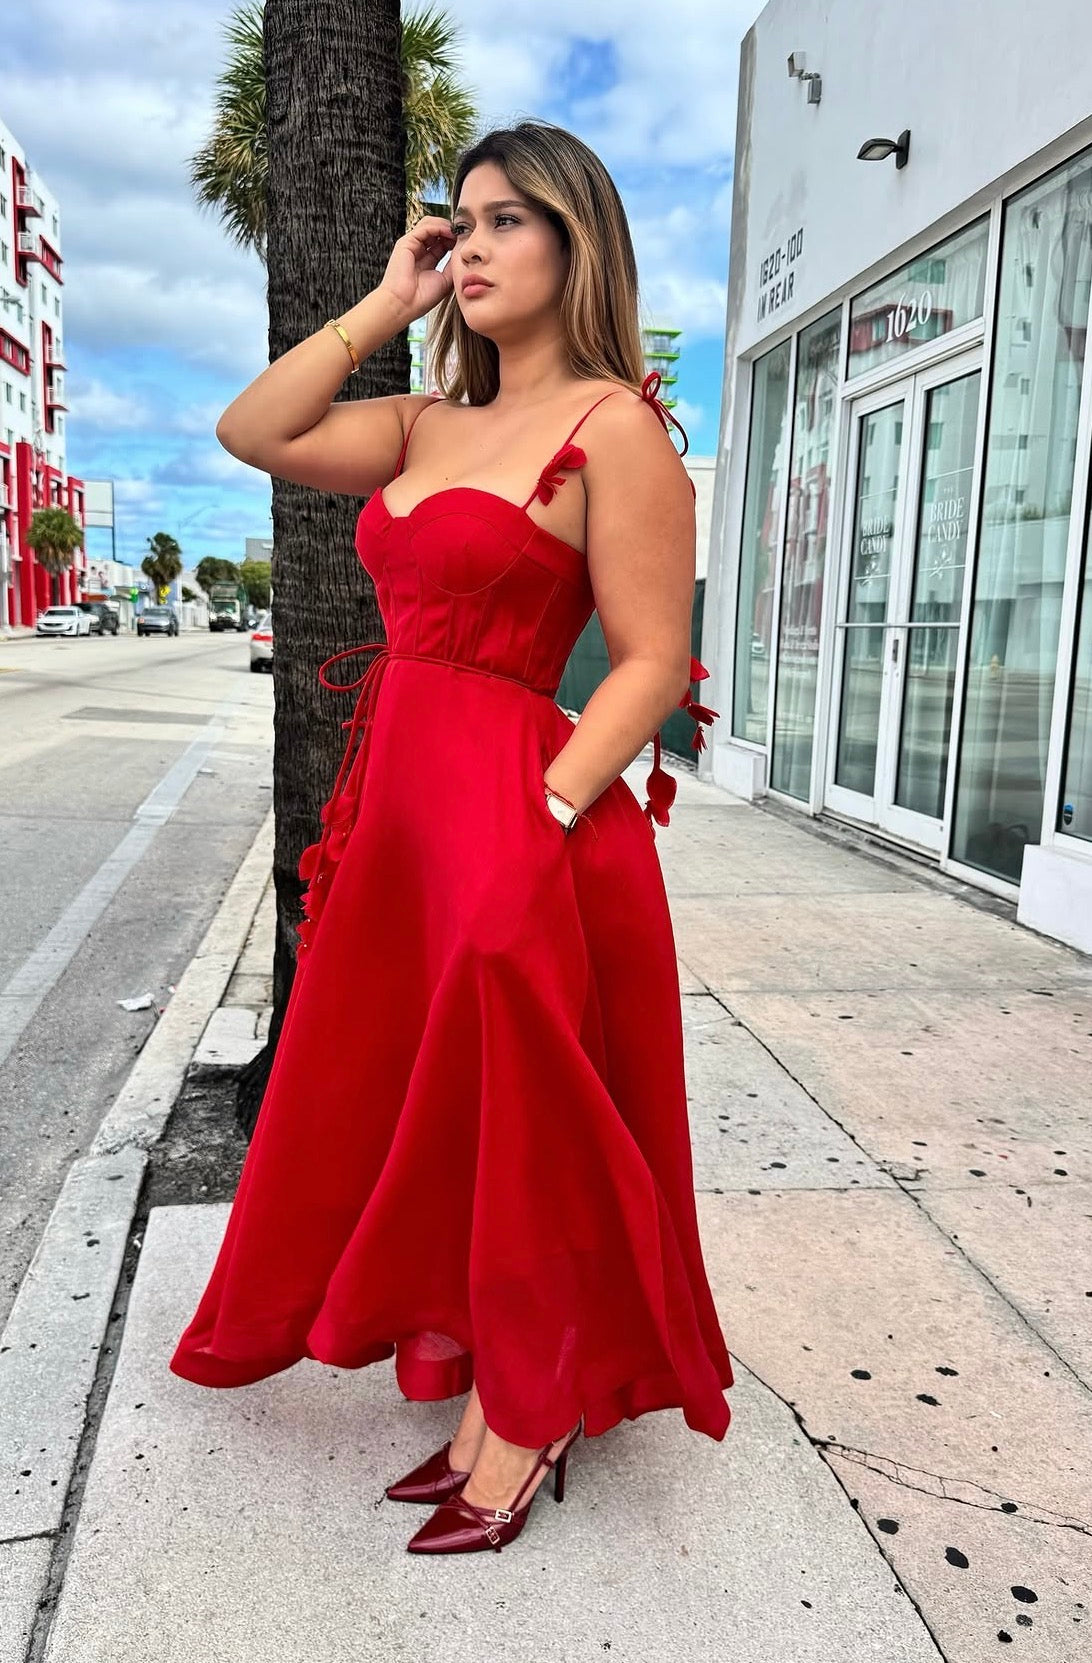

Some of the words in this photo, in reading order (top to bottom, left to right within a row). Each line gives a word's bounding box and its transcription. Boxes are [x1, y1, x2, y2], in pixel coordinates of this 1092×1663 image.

[760, 227, 803, 288] 1620-100
[757, 293, 767, 322] IN
[768, 271, 794, 314] REAR
[886, 290, 931, 343] 1620
[930, 497, 964, 522] BRIDE
[862, 516, 889, 537] BRIDE
[927, 520, 960, 543] CANDY
[860, 535, 886, 556] CANDY
